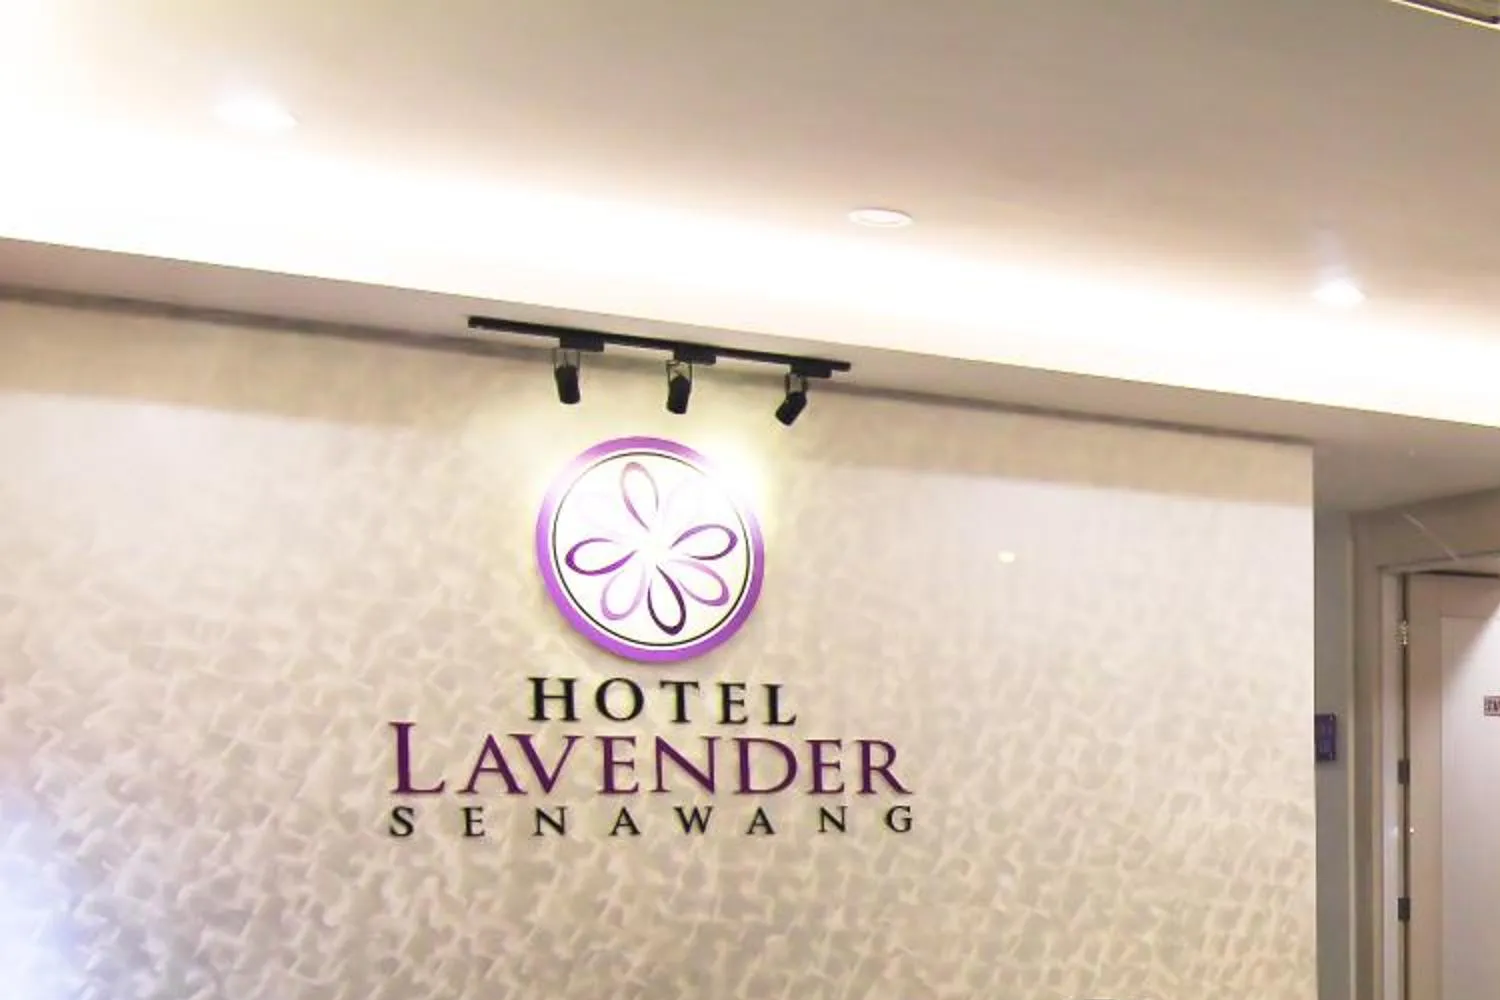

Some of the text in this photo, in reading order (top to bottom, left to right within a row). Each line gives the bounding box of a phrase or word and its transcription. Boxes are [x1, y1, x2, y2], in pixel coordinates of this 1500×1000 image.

[528, 676, 797, 727] HOTEL
[388, 721, 914, 796] LAVENDER
[388, 804, 914, 838] SENAWANG
